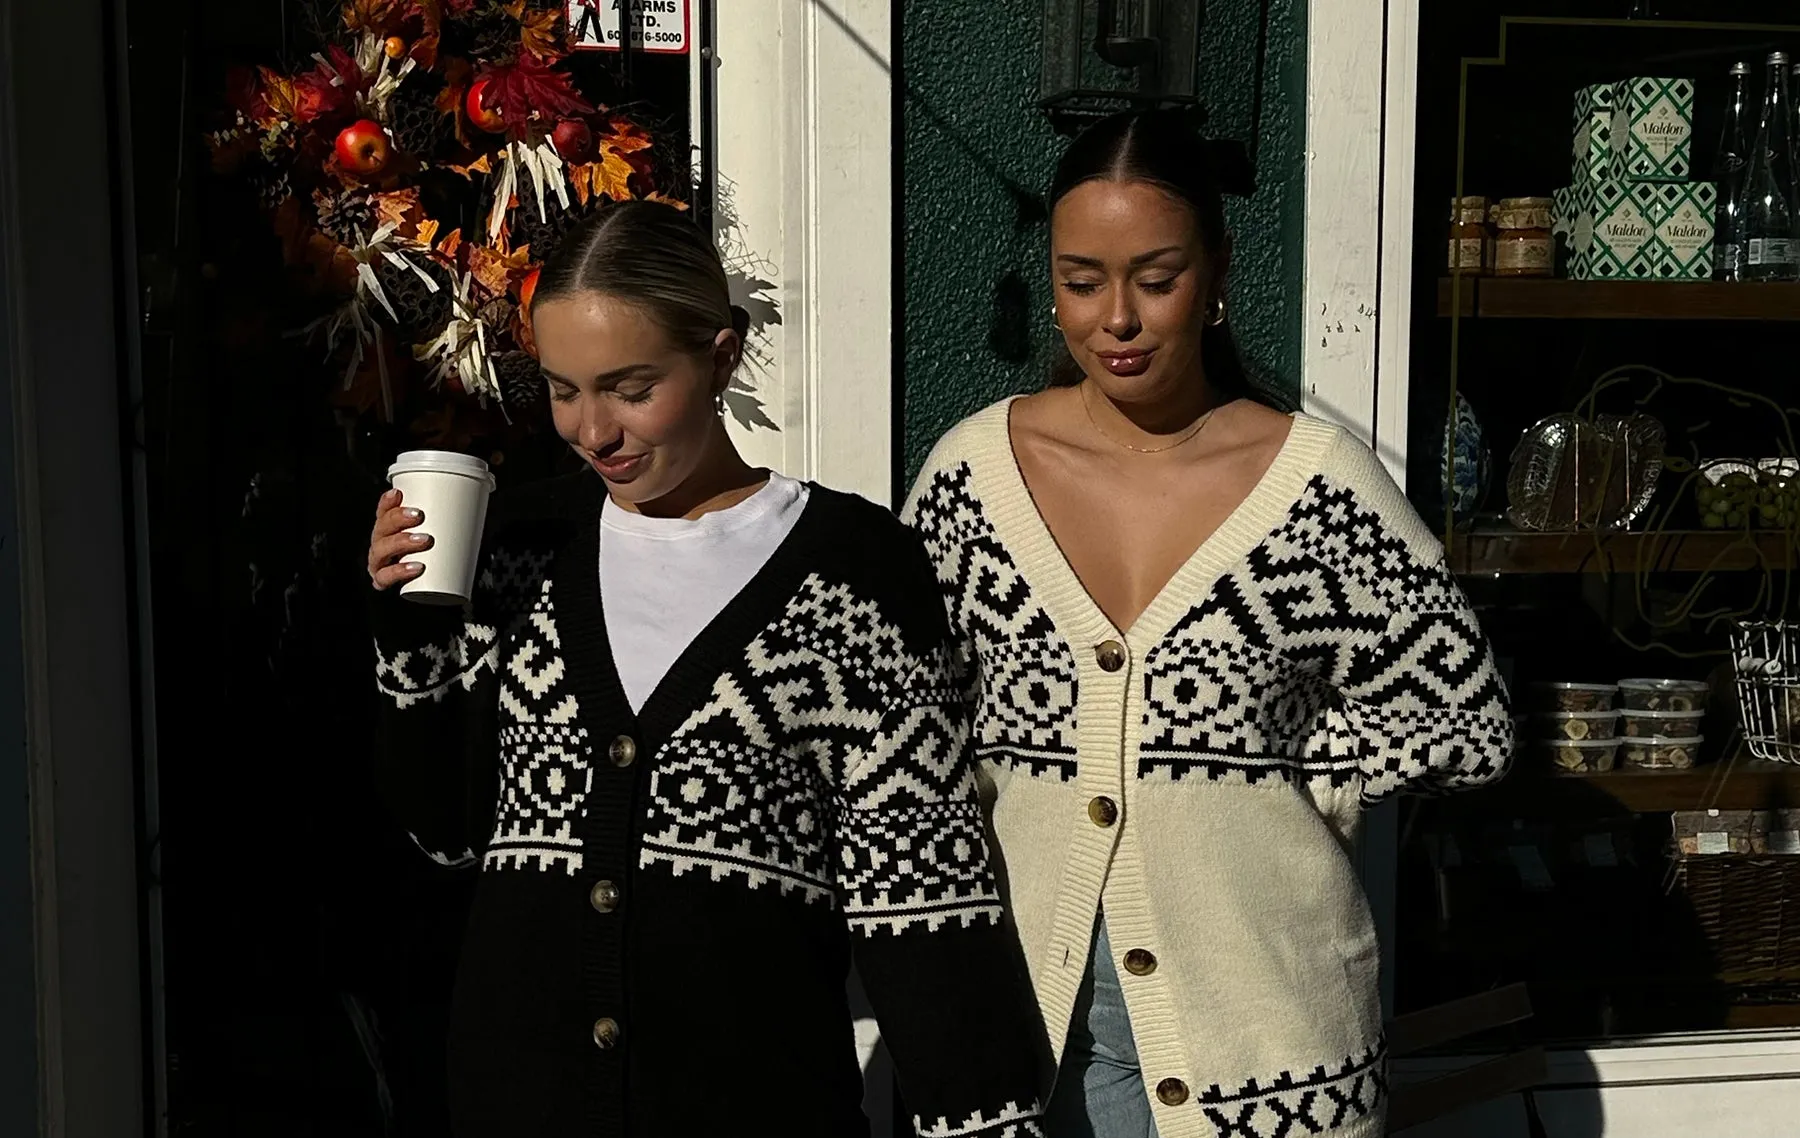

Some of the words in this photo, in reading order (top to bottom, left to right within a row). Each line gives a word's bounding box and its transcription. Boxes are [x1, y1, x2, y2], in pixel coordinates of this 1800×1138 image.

[611, 0, 676, 13] AARMS
[629, 15, 661, 27] LTD.
[1642, 122, 1684, 135] Maldon
[1605, 223, 1647, 237] Maldon
[1666, 225, 1708, 237] Maldon
